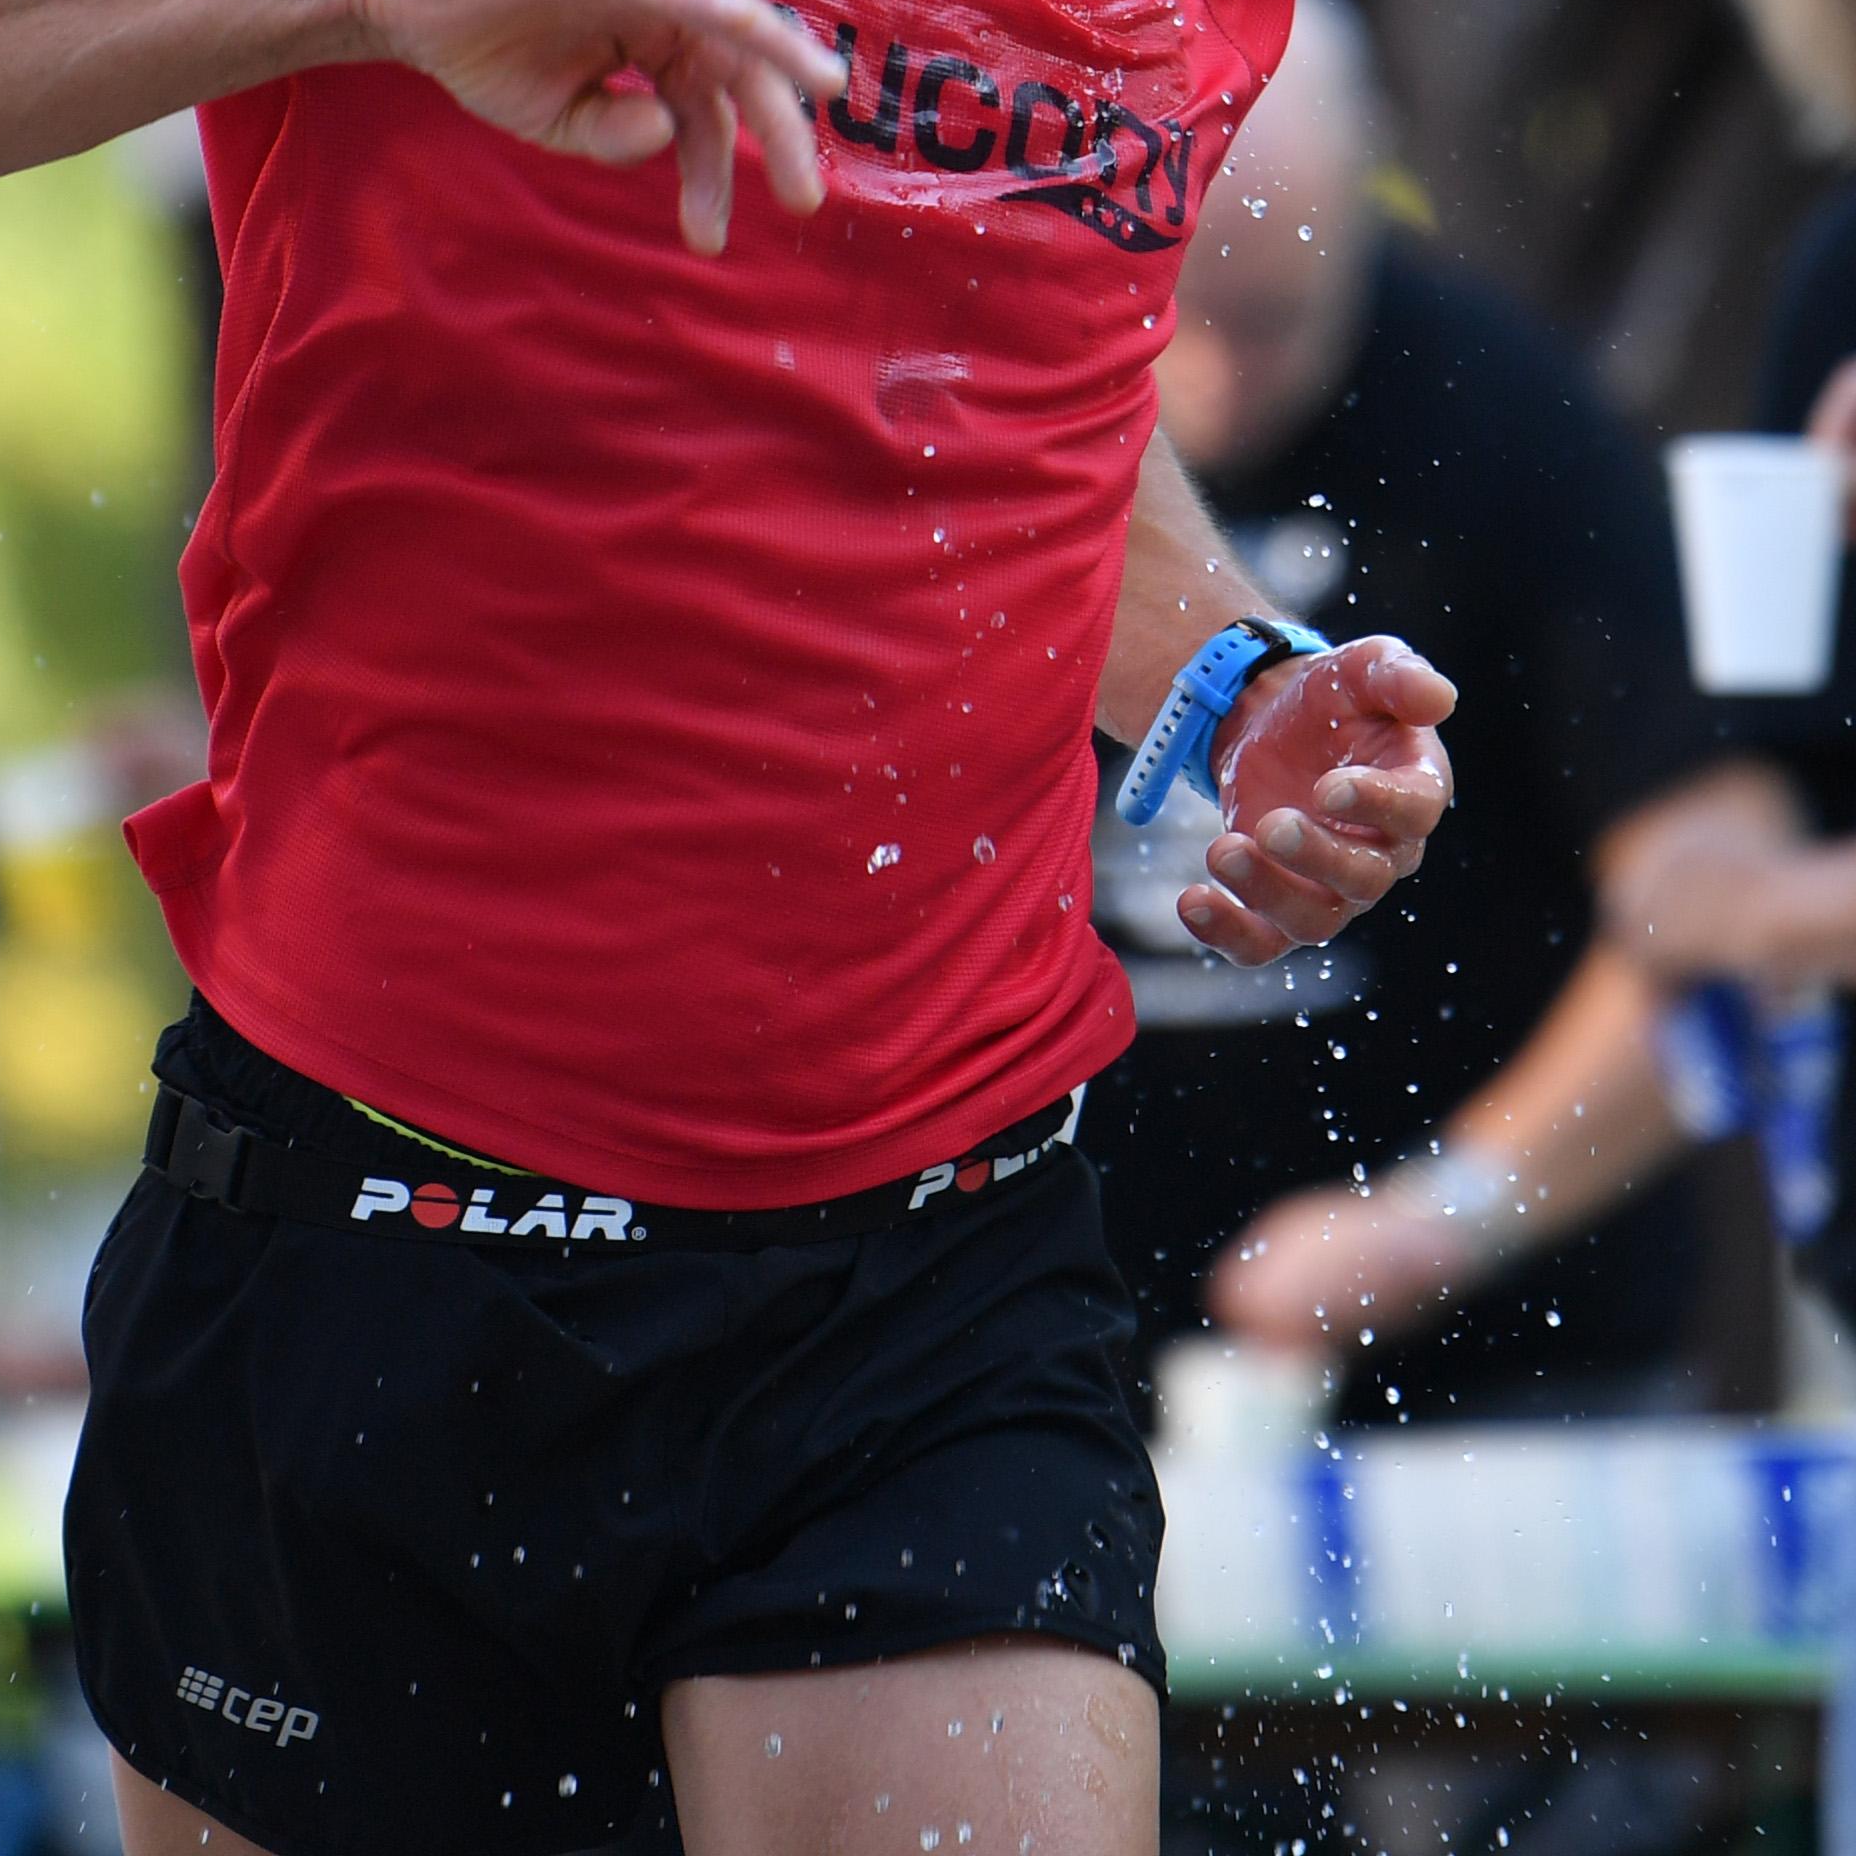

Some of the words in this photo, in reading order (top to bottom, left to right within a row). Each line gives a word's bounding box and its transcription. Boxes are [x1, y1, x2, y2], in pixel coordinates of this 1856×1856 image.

[772, 2, 1194, 227] ucony
[350, 1177, 634, 1241] POLAR
[221, 1686, 320, 1748] cep
